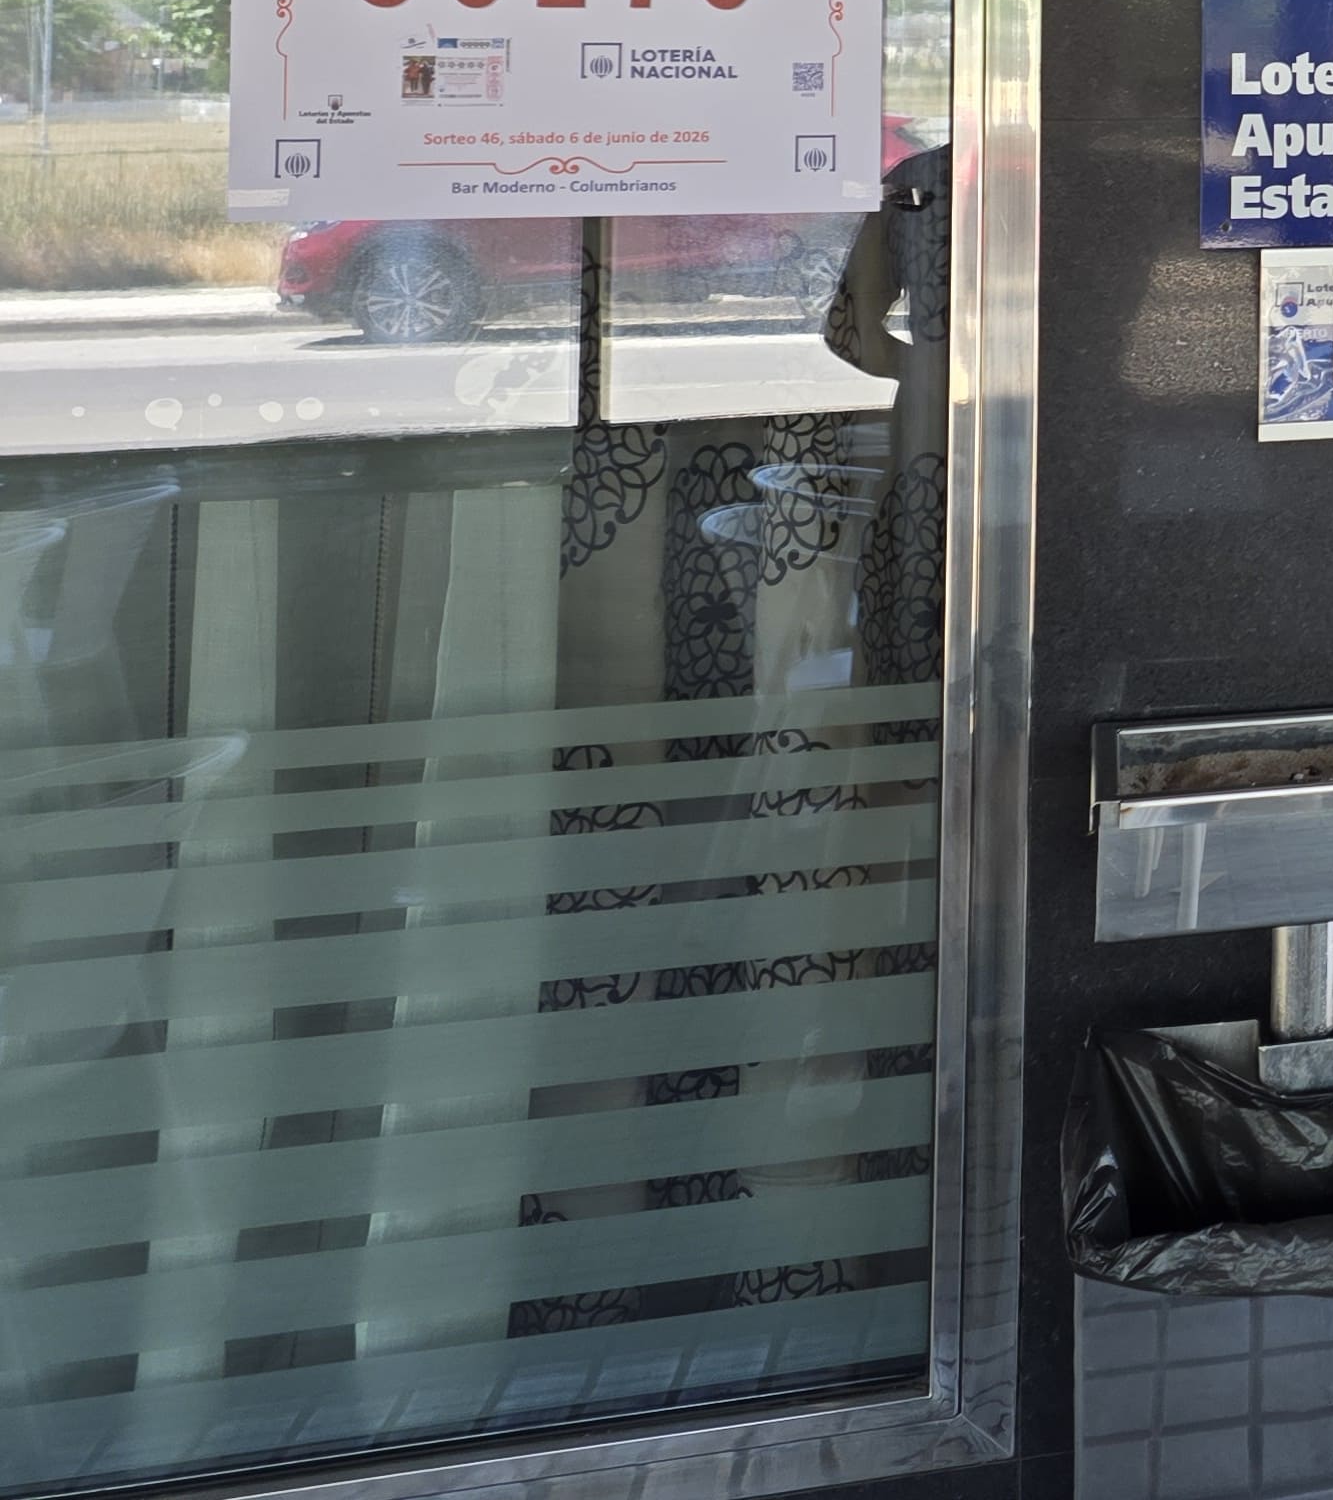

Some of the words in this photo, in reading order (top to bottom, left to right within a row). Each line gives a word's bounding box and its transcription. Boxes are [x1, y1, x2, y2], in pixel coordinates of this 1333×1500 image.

[630, 45, 717, 64] LOTERÍA
[630, 63, 739, 80] NACIONAL
[424, 131, 476, 146] Sorteo
[481, 131, 504, 148] 46,
[509, 128, 564, 146] sábado
[570, 131, 579, 145] 6
[583, 130, 602, 145] de
[605, 129, 645, 149] junio
[649, 130, 667, 145] de
[672, 130, 710, 144] 2026
[451, 180, 478, 195] Bar
[482, 179, 555, 195] Moderno
[570, 178, 677, 194] Columbrianos
